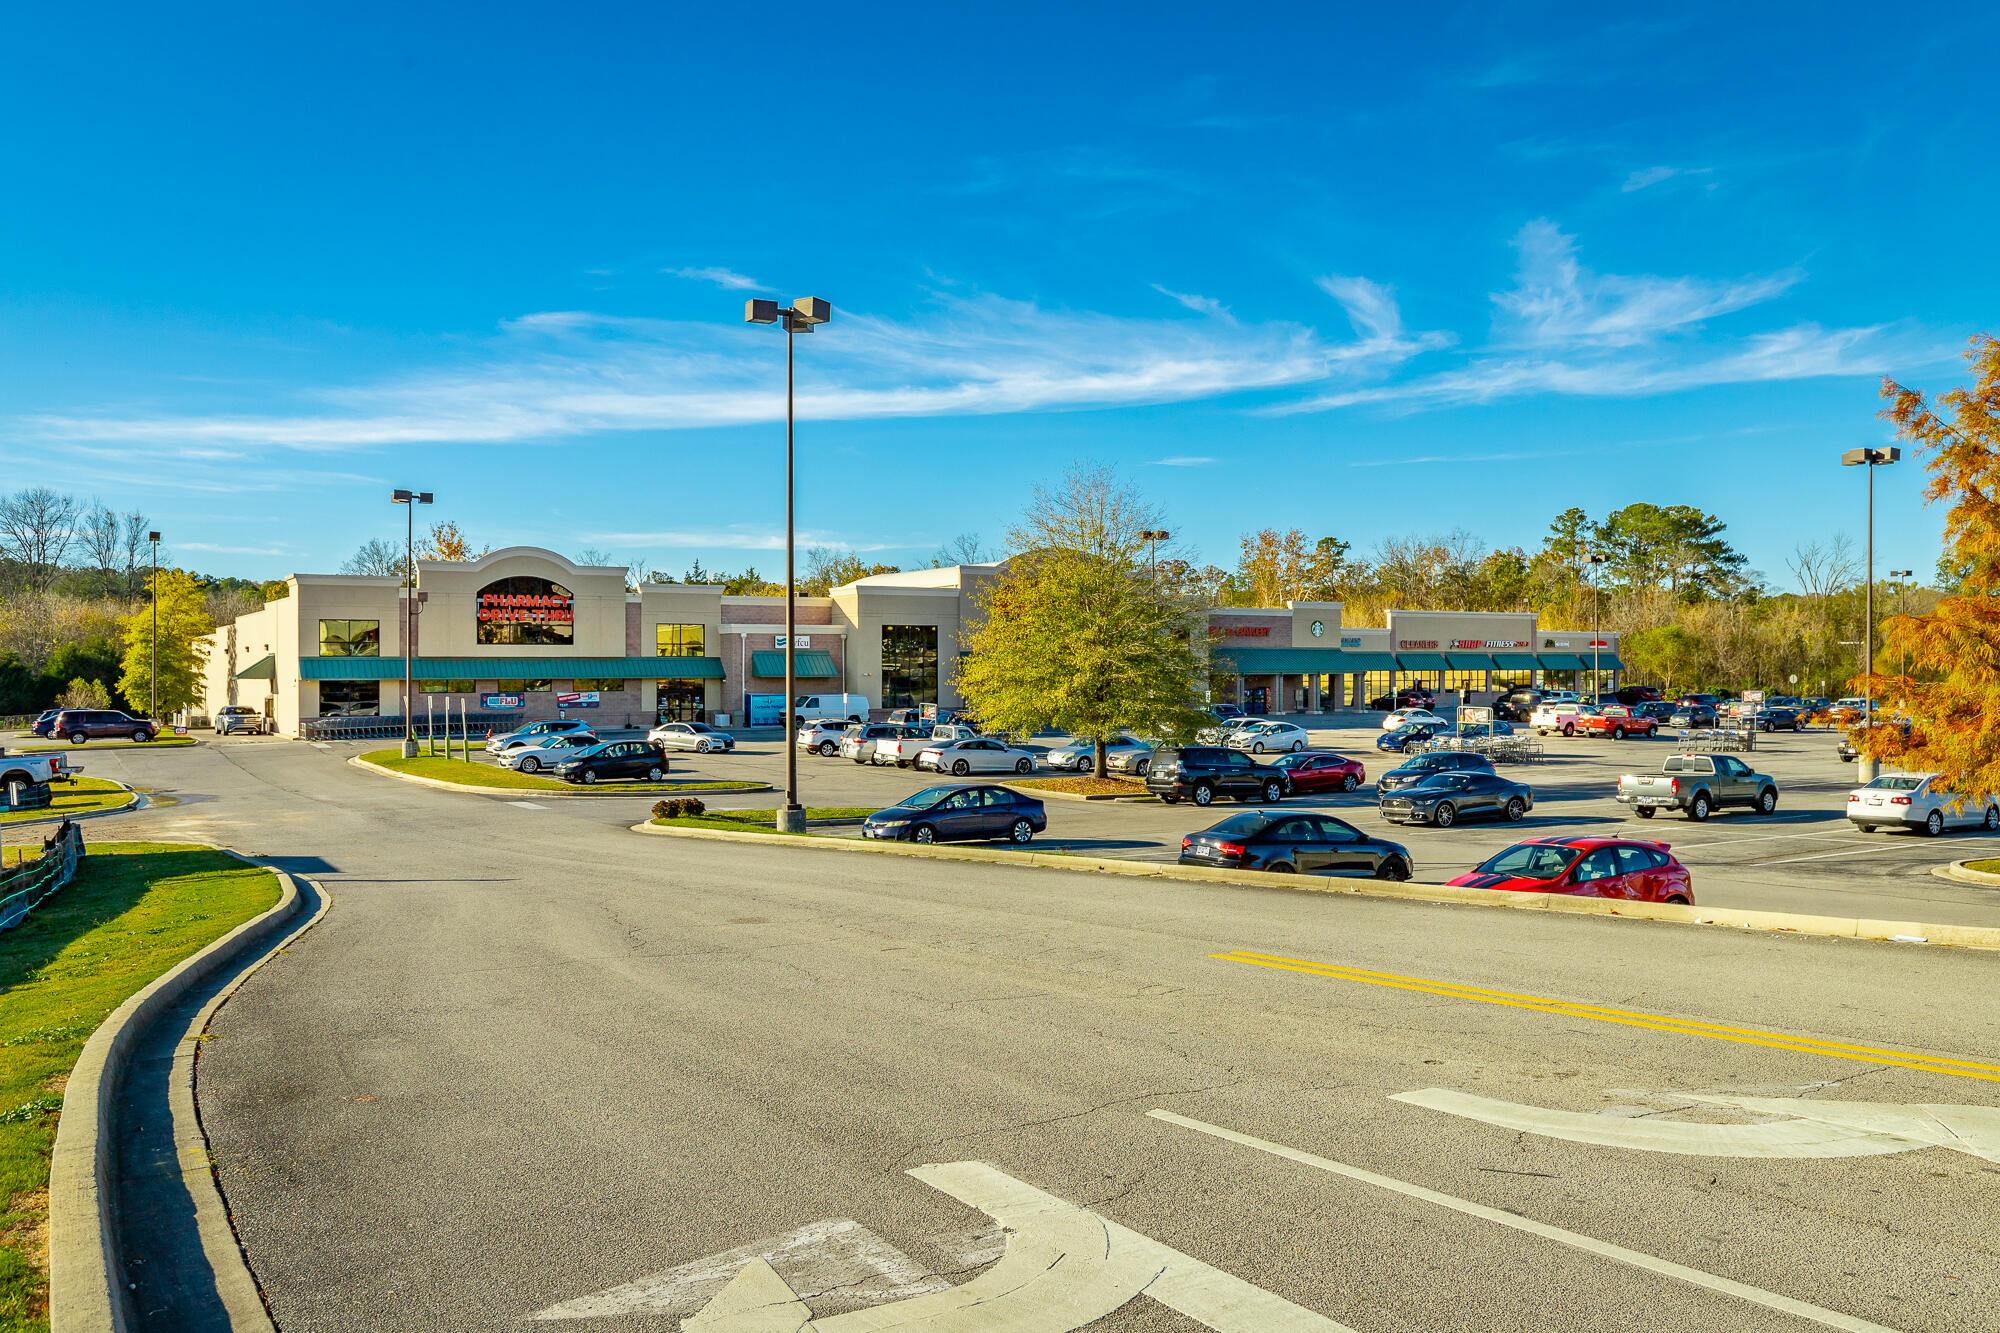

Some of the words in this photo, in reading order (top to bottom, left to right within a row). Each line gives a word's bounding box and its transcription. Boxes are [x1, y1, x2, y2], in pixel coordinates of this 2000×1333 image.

[483, 594, 569, 607] PHARMACY
[480, 608, 574, 622] DRIVE-THRU
[1236, 626, 1272, 637] BAKERY
[1400, 640, 1439, 649] CLEANERS
[1459, 640, 1483, 649] SNAP
[1486, 640, 1514, 648] FITNESS
